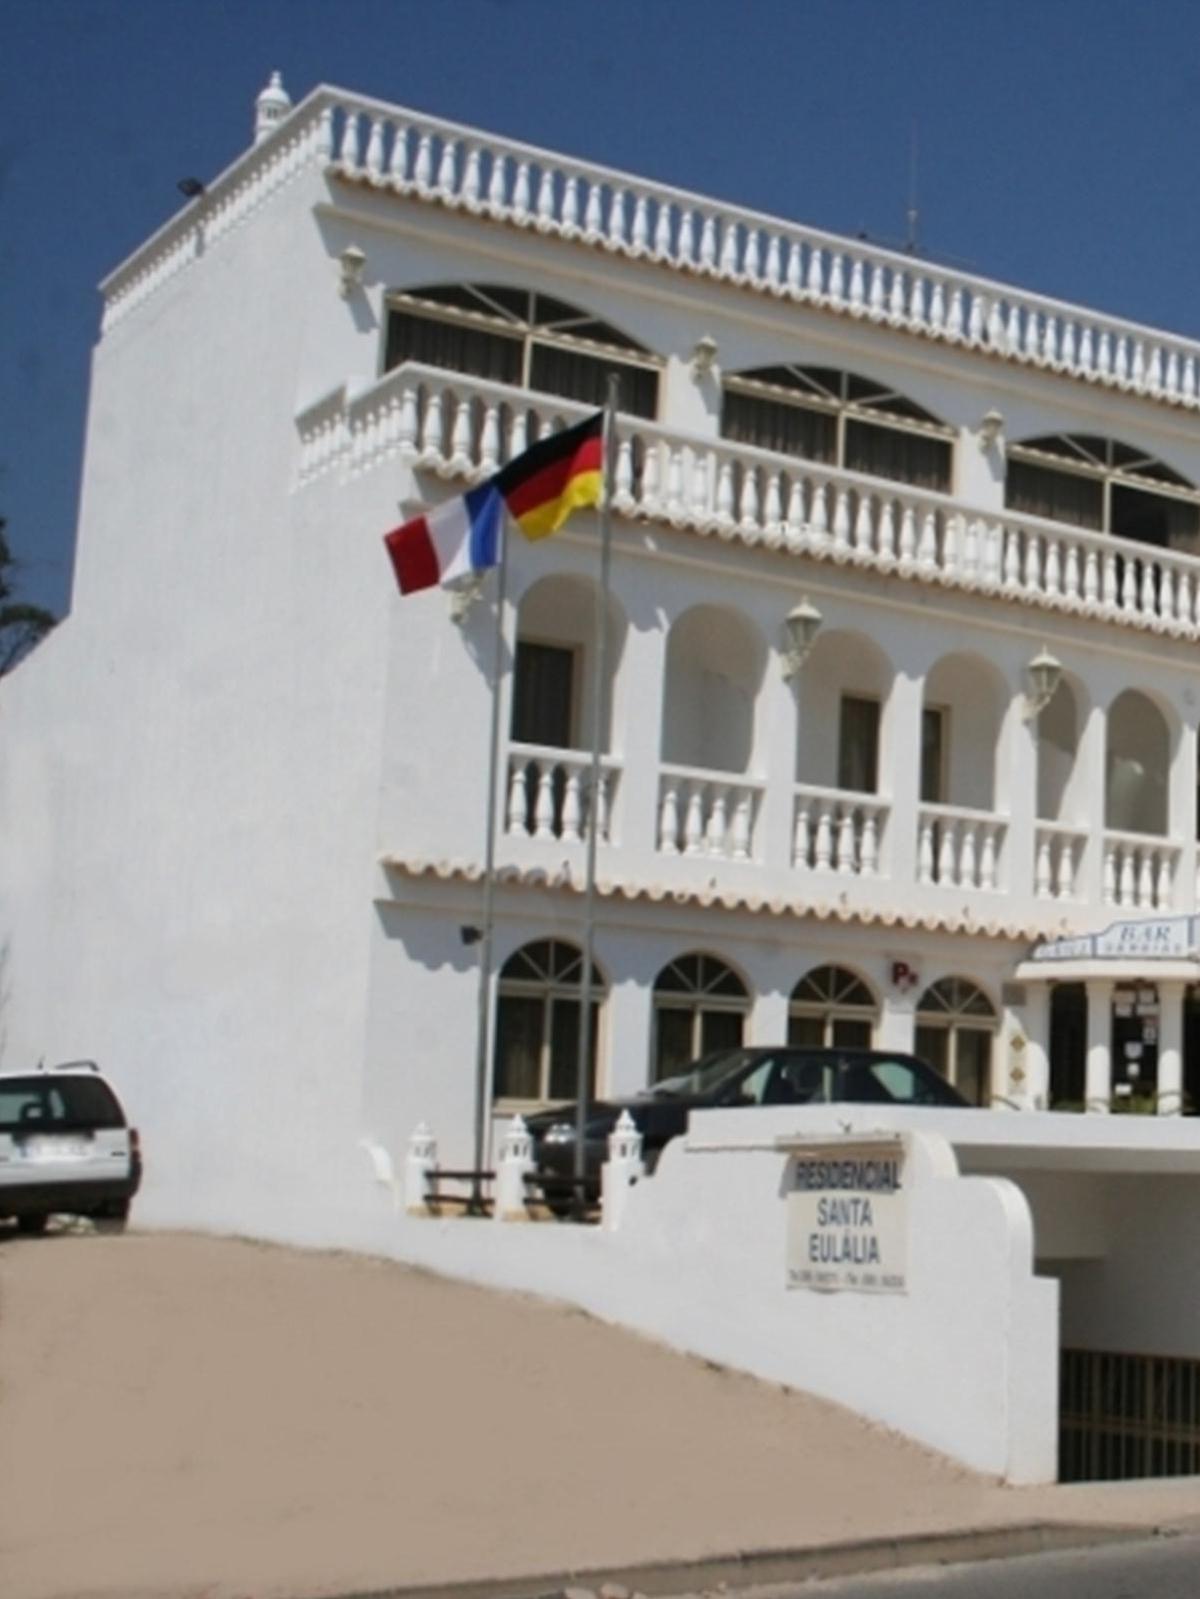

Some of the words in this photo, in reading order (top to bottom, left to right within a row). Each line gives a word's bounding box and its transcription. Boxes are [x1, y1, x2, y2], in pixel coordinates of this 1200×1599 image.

[1120, 926, 1171, 941] BAR
[797, 1160, 901, 1190] RESIDENCIAL
[817, 1198, 873, 1226] SANTA
